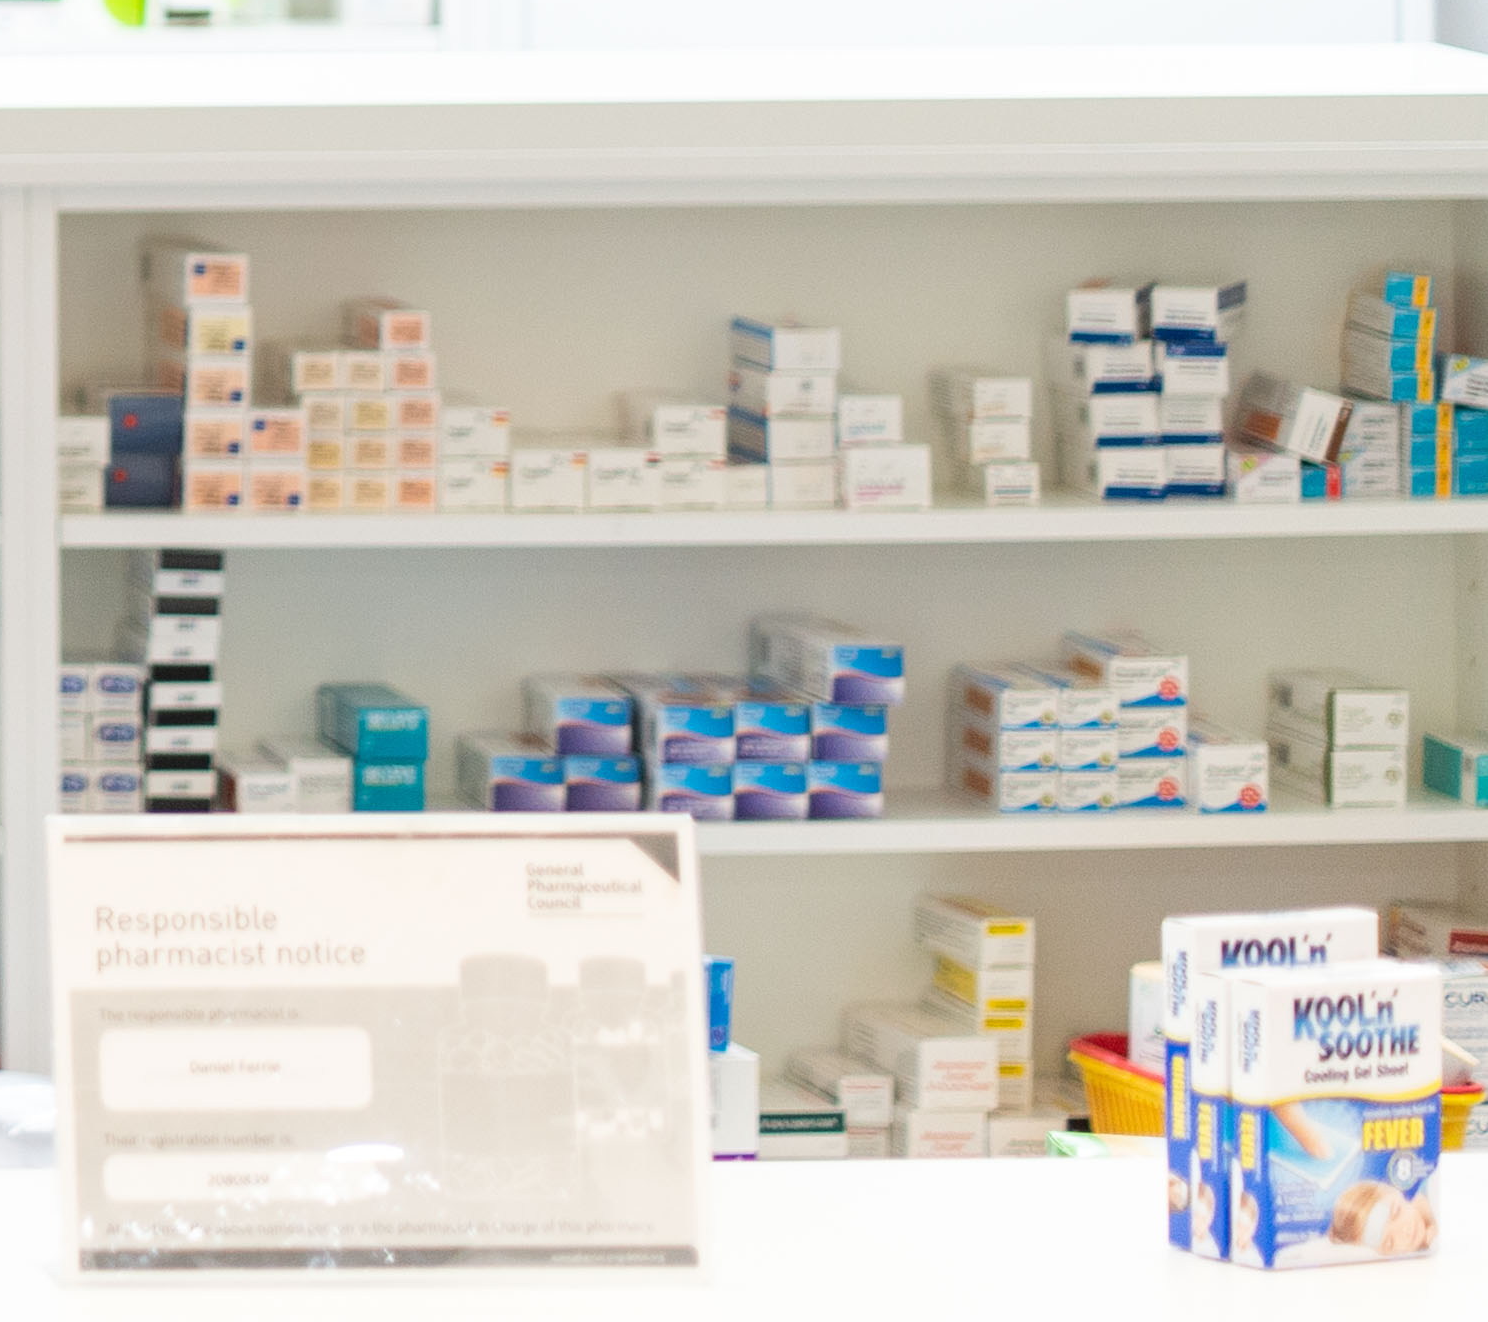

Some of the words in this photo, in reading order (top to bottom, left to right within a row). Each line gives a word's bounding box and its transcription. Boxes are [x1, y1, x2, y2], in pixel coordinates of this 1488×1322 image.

[526, 862, 585, 878] General
[526, 878, 643, 894] Pharmaceutical
[526, 895, 583, 911] Council
[94, 905, 279, 939] Responsible
[95, 939, 266, 974] pharmacist
[276, 939, 367, 966] notice
[1318, 1023, 1420, 1062] SOOTHE
[1304, 1068, 1350, 1083] Cooling
[1354, 1064, 1372, 1079] Gel
[1377, 1061, 1409, 1077] Sheet
[1362, 1116, 1425, 1152] FEVER
[1397, 1158, 1412, 1182] 8
